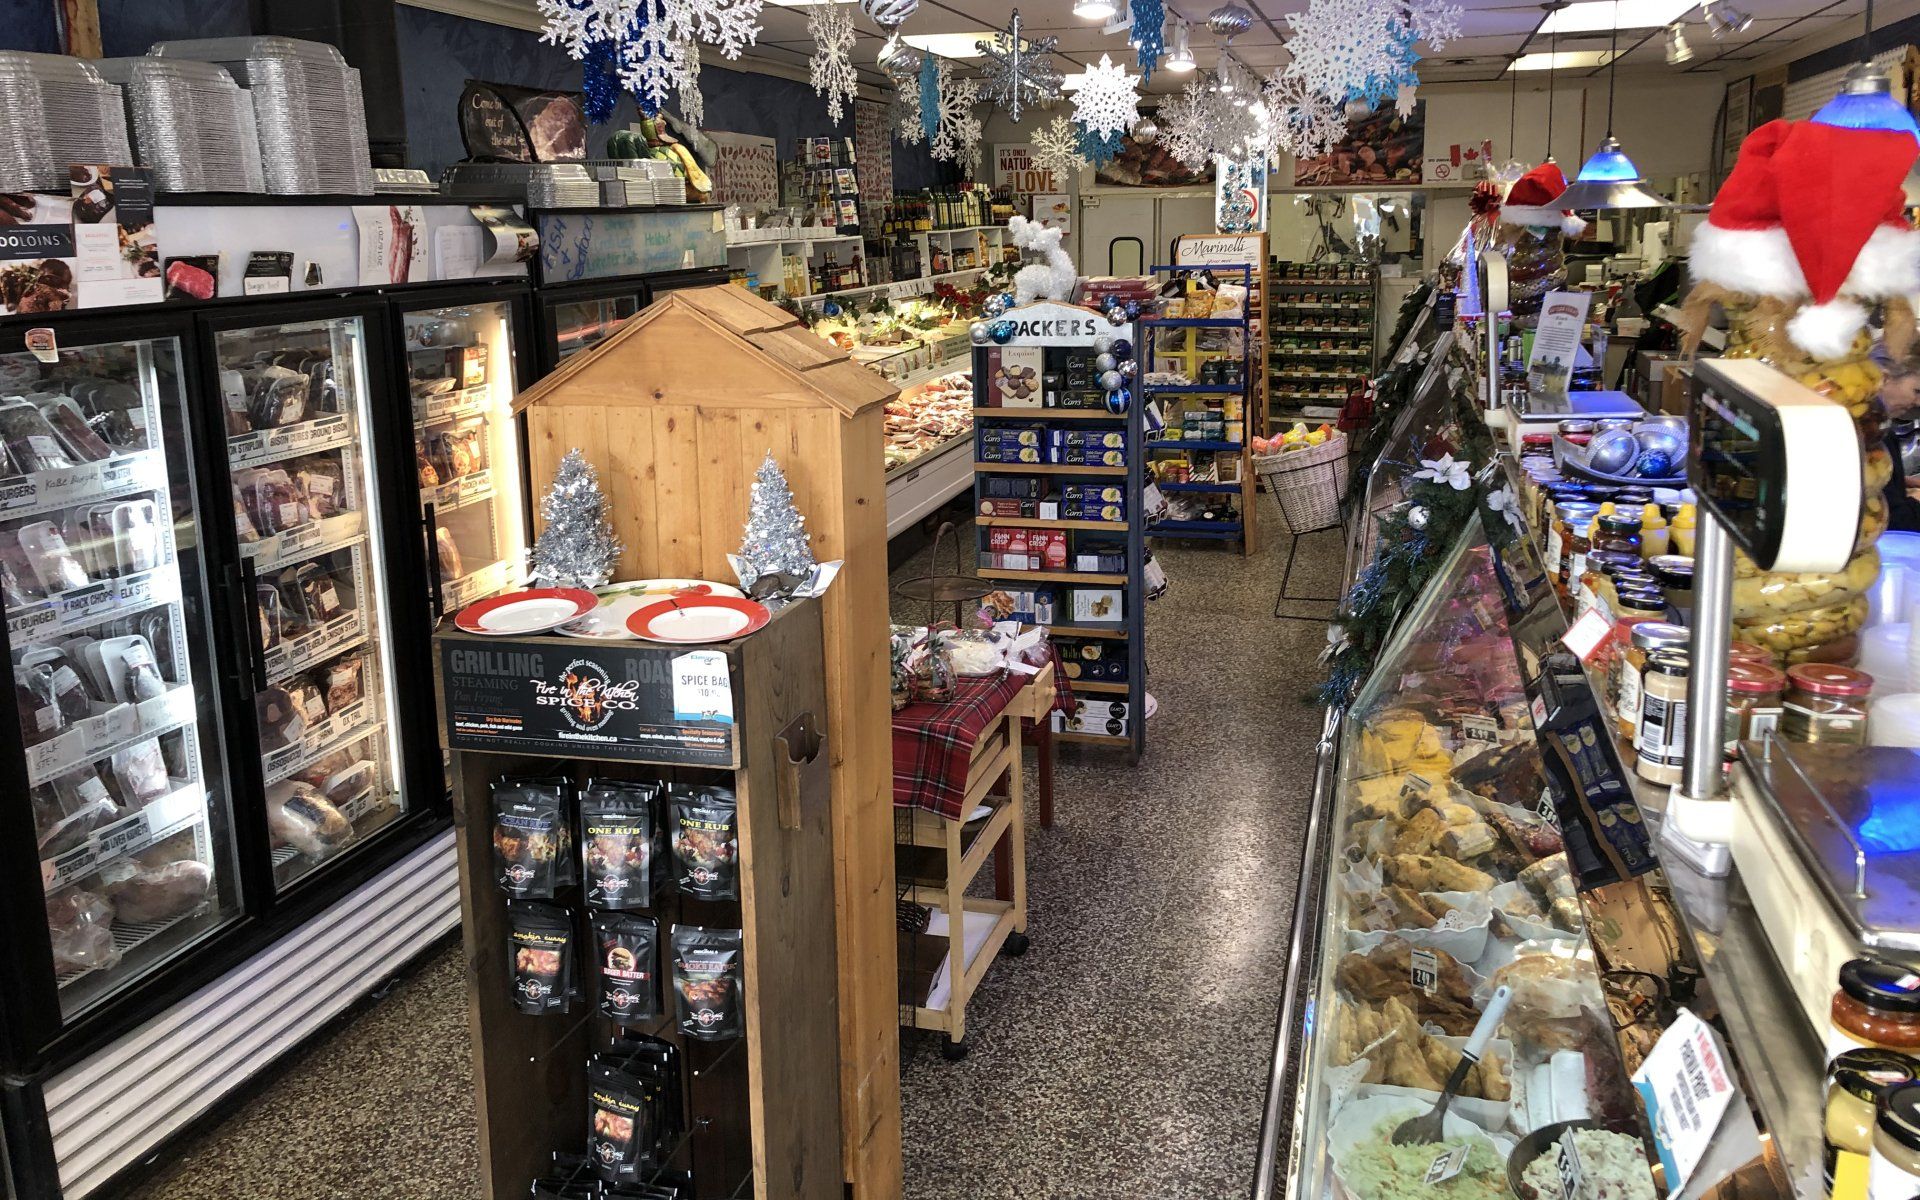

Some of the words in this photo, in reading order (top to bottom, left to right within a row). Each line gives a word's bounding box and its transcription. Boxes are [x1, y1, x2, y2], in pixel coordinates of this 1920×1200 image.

[1012, 149, 1027, 157] ONLY
[1000, 157, 1050, 171] NATUR
[1015, 170, 1058, 192] LOVE
[375, 220, 385, 266] 2016/2017
[1181, 236, 1247, 258] Marinelli
[1000, 319, 1097, 337] RACKERS
[120, 588, 134, 599] ELK
[21, 610, 57, 630] BURGER
[327, 626, 344, 641] ENISON
[451, 649, 545, 678] GRILLING
[565, 659, 585, 674] perfect
[625, 658, 673, 684] ROAS
[452, 676, 519, 691] STEAMING
[681, 674, 708, 686] SPICE
[597, 680, 640, 702] Kitchen
[536, 696, 596, 708] SPICE
[602, 700, 640, 710] CO.
[588, 826, 612, 835] ONE
[614, 826, 640, 835] RUB
[680, 818, 702, 828] ONE
[704, 821, 730, 831] RUB
